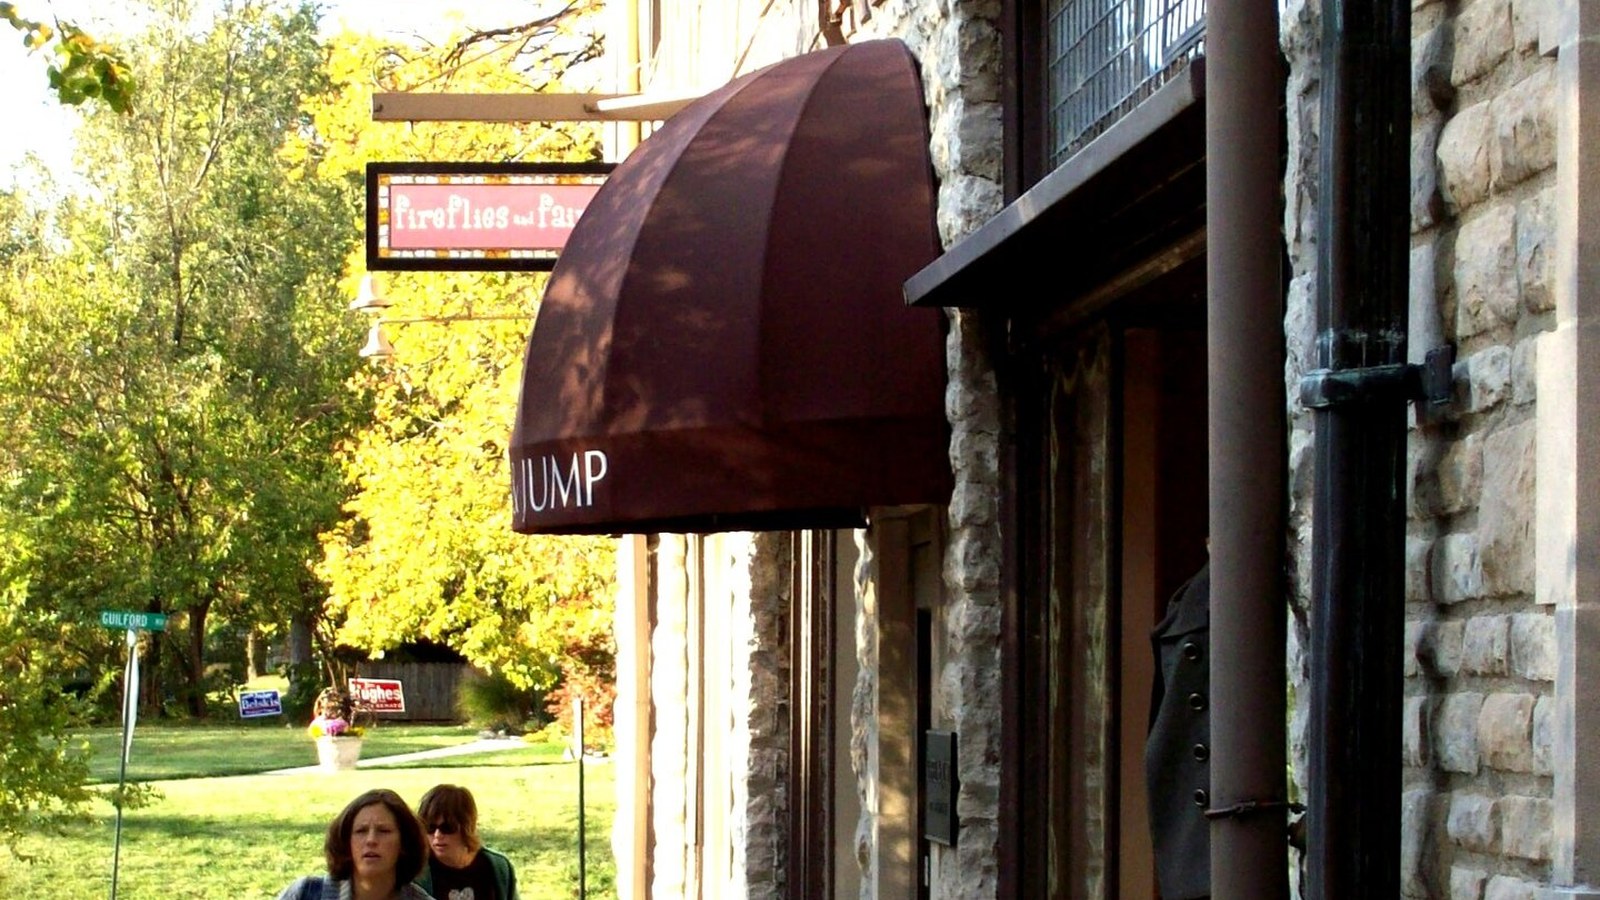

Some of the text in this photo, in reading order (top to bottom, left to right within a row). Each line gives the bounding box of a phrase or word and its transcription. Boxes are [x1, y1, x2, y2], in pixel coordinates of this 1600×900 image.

[394, 193, 509, 230] fireflies
[513, 211, 534, 226] and
[102, 611, 148, 628] GUILFORD
